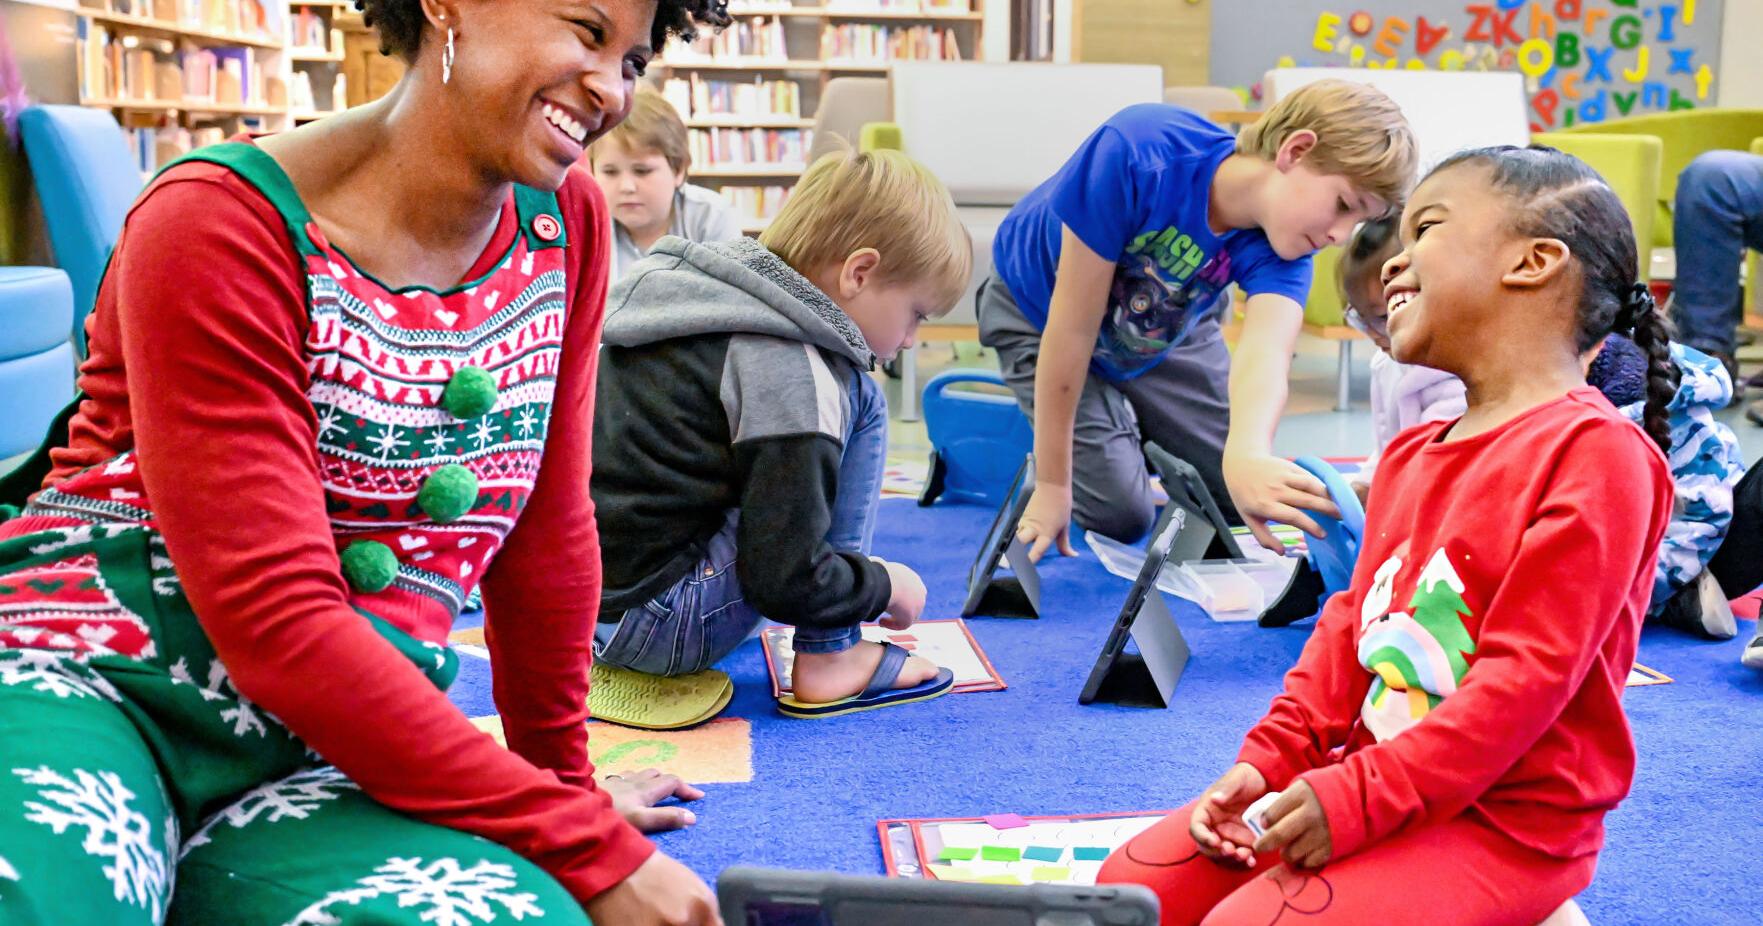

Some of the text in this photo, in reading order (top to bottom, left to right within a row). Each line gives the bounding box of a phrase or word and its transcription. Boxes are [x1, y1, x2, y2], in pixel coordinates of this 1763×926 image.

[1313, 12, 1340, 52] E
[1555, 32, 1579, 66] B
[1611, 15, 1641, 49] G
[1624, 46, 1648, 82] J
